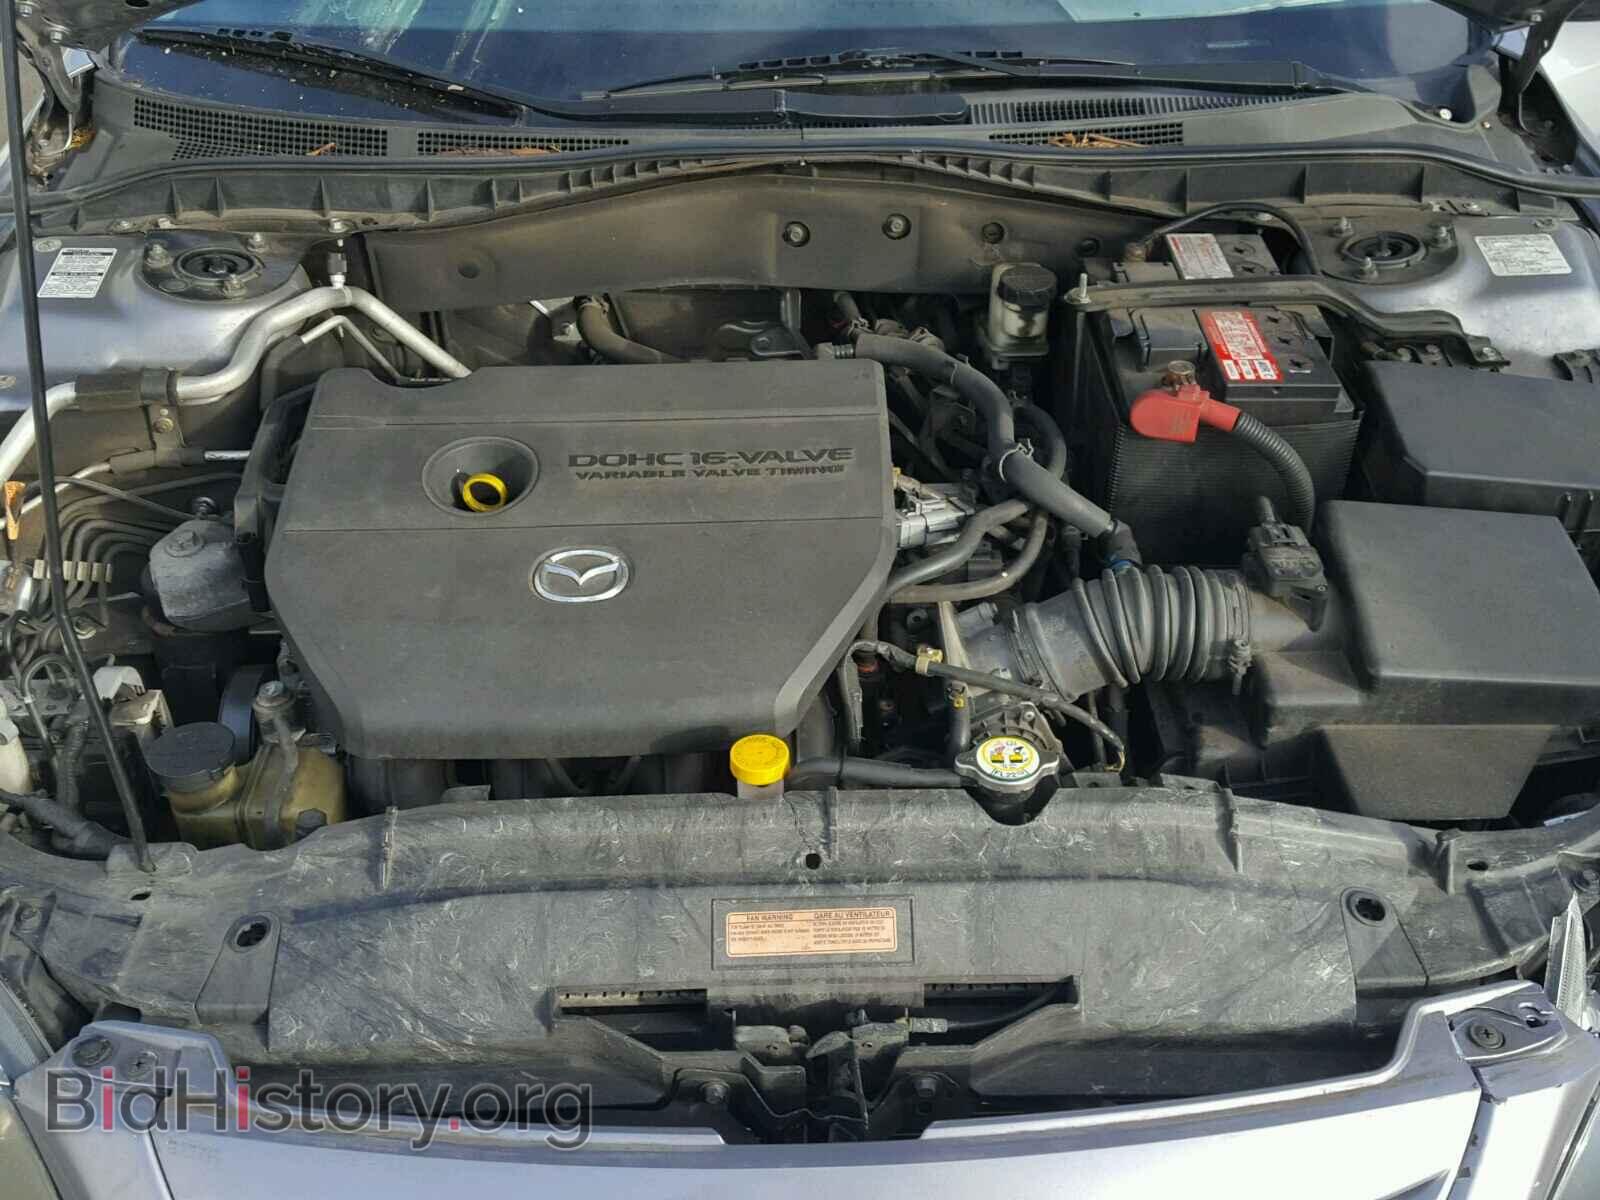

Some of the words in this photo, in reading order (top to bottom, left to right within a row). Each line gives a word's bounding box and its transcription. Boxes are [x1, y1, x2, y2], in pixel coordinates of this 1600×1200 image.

[568, 453, 683, 467] DOHC
[690, 447, 854, 465] 16-VALVE
[575, 469, 686, 480] VARIABLE
[692, 467, 761, 478] VALVE
[746, 913, 760, 921] FAN
[761, 912, 793, 921] WARNING
